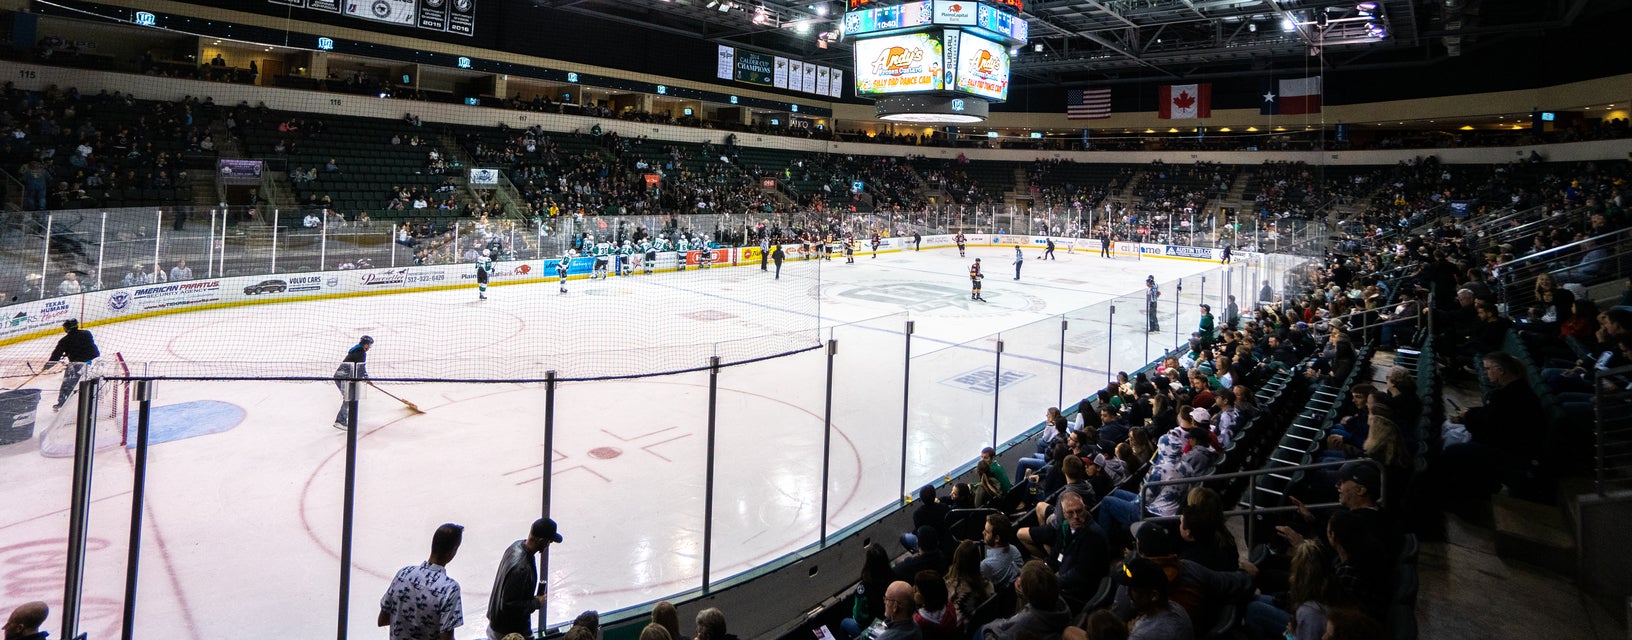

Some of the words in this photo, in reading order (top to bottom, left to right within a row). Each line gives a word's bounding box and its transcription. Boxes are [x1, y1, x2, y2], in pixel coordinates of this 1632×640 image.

[738, 62, 770, 73] CHAMPIONS
[871, 46, 924, 74] Andy's
[969, 49, 1000, 73] Andy's
[19, 70, 35, 79] 115
[134, 285, 179, 296] AMERICAN
[179, 281, 219, 290] PARATUS
